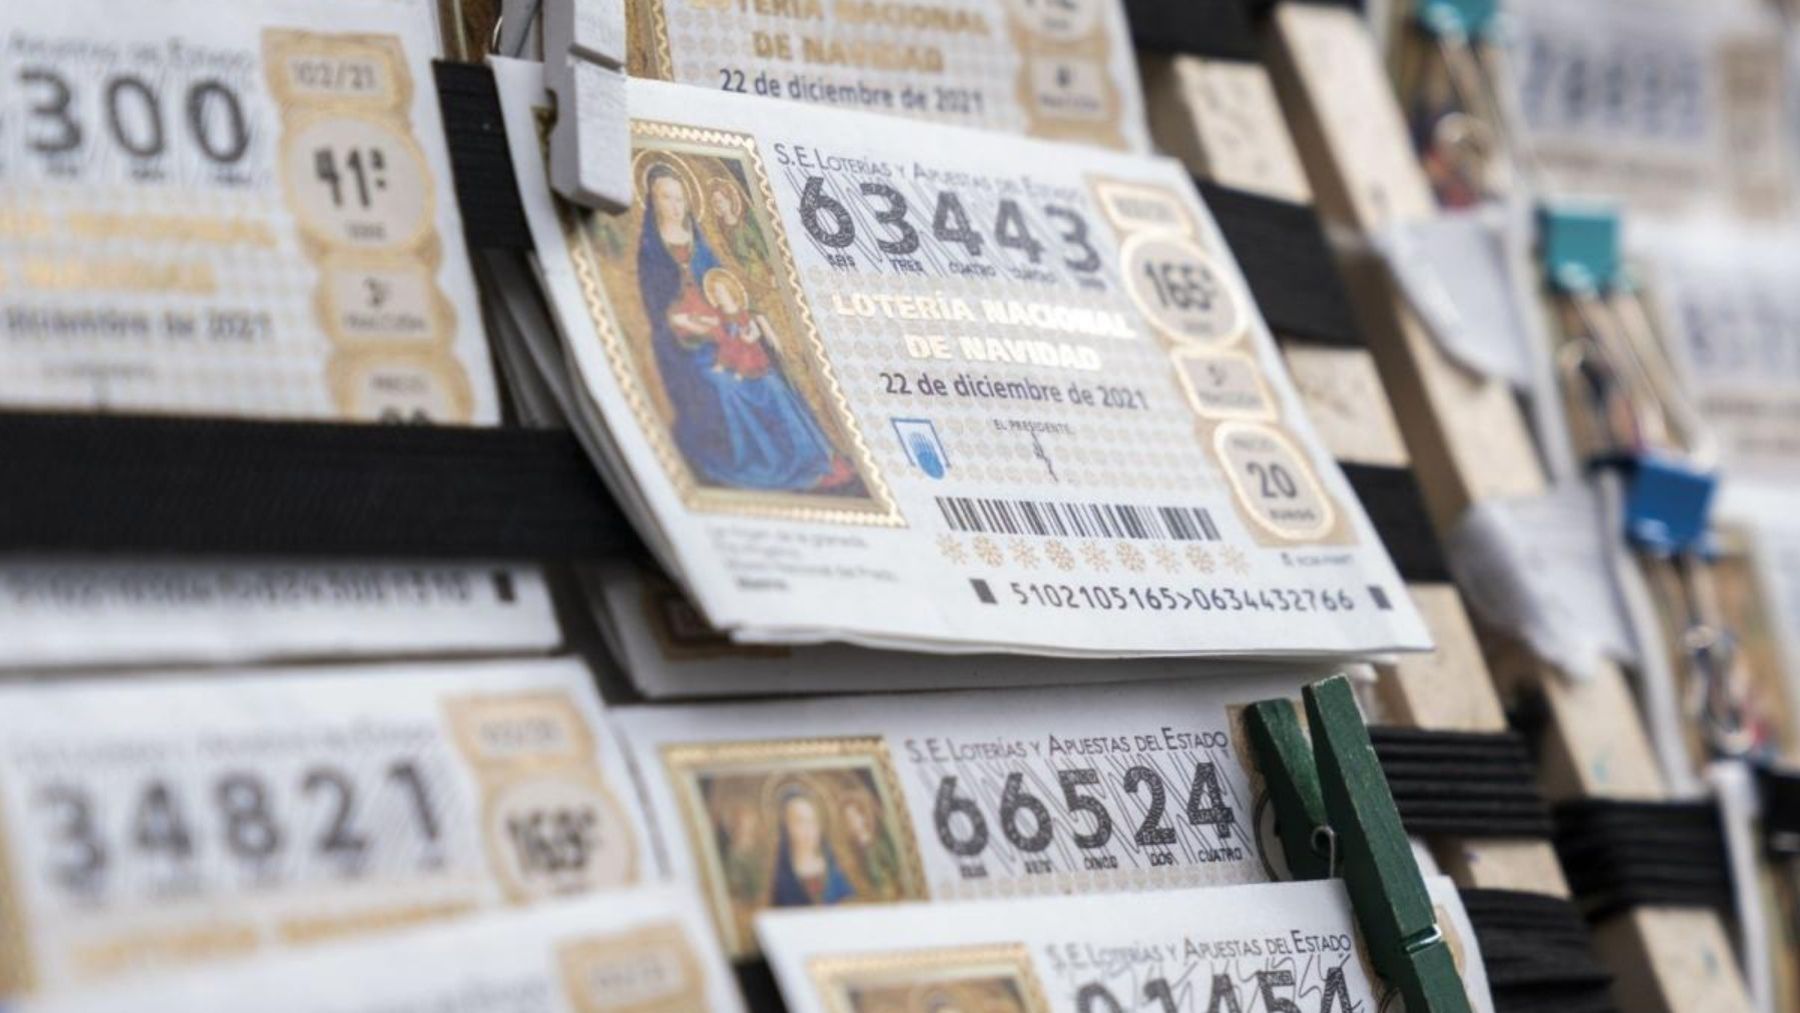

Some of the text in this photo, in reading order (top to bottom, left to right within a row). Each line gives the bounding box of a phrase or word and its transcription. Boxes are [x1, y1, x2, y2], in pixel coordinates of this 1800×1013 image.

[752, 31, 793, 60] DE
[719, 68, 984, 112] 22 de diciembre de 2021
[800, 176, 1101, 272] 63443
[832, 290, 1136, 338] LOTERÍA NACIONAL
[904, 334, 1100, 371] DE NAVIDAD
[880, 373, 1148, 410] 22 de diciembre de 2021
[1246, 461, 1298, 499] 20
[1050, 734, 1130, 756] APUESTAS
[1135, 734, 1162, 752] DEL
[1162, 727, 1228, 750] ESTADO
[934, 762, 1235, 856] 66524
[1151, 852, 1173, 867] DOS
[1199, 848, 1243, 863] CUATRO
[1184, 937, 1261, 962] APUESTAS
[1266, 937, 1290, 955] DEL
[1291, 930, 1350, 952] ESTADO
